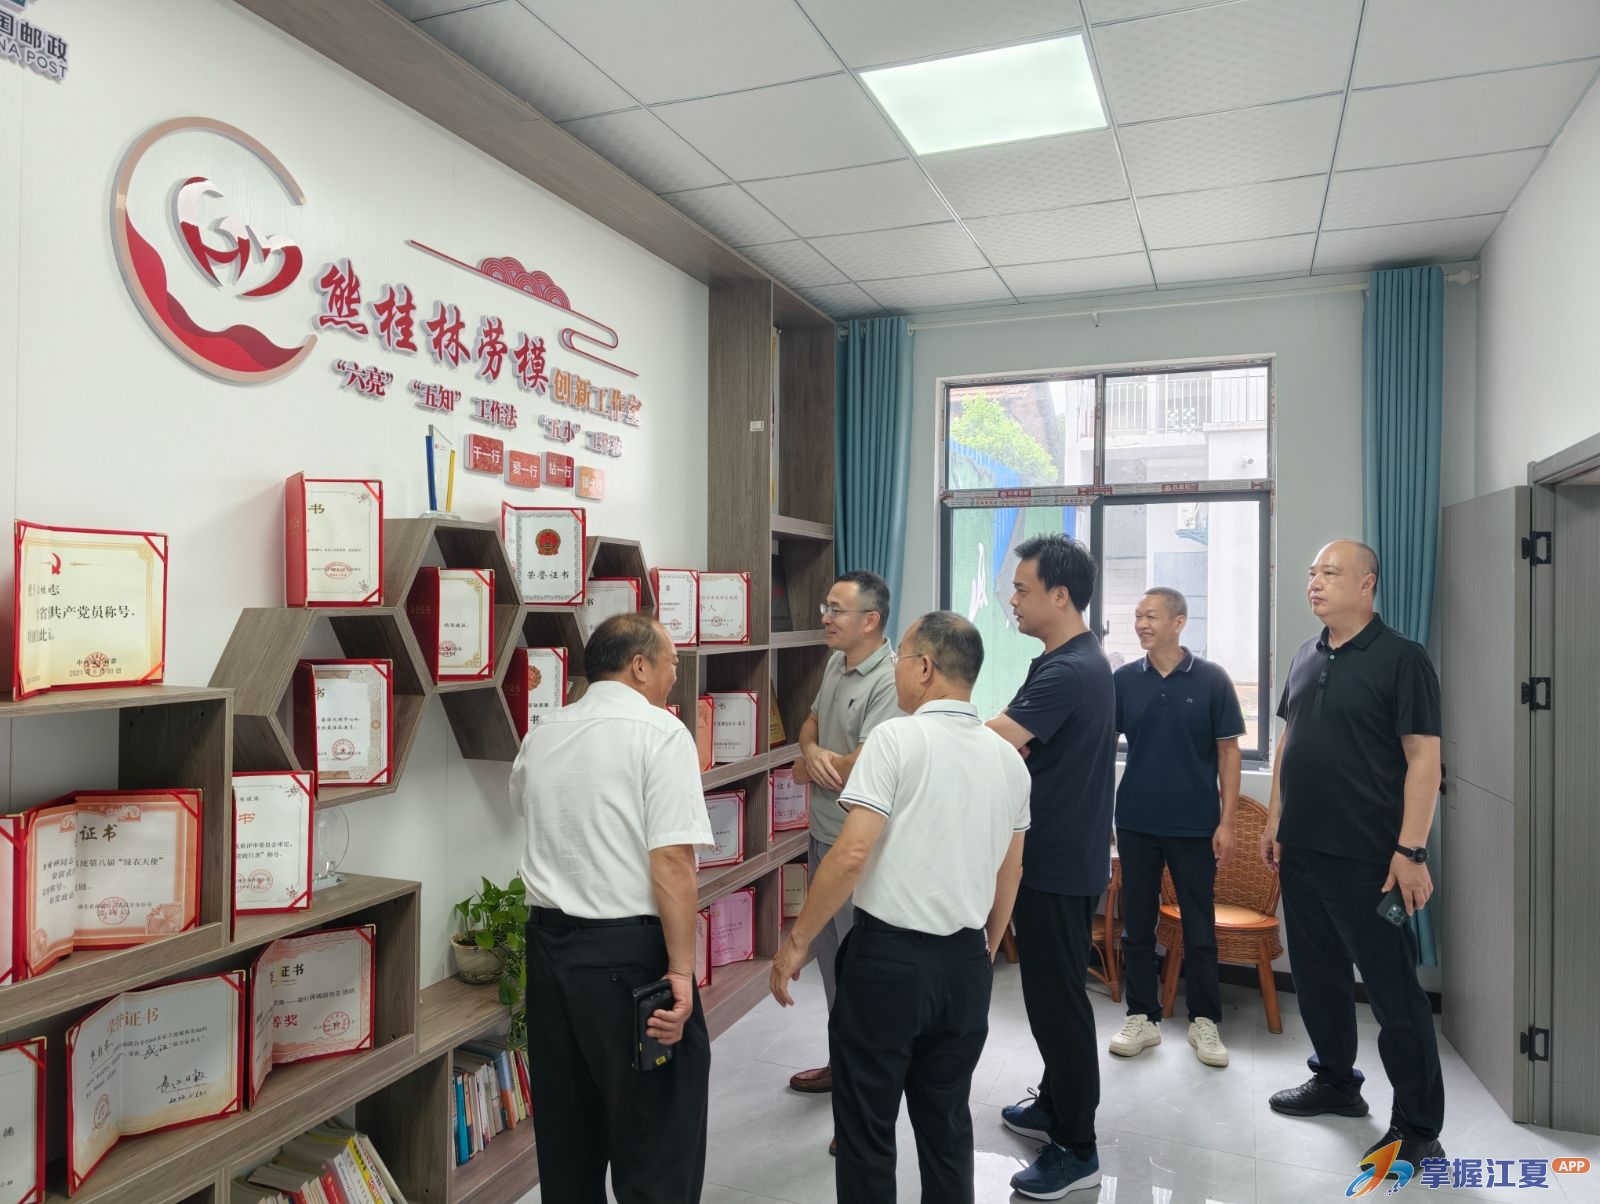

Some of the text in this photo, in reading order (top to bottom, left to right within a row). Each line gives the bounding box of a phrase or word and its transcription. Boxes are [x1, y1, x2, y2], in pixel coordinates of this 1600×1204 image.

[27, 50, 67, 78] POST
[318, 259, 643, 426] 熊桂林劳模 创新工作室
[336, 359, 394, 397] “六亮”
[412, 380, 462, 412] “五知”
[472, 398, 518, 429] 工作法
[473, 445, 500, 464] 干一行
[512, 461, 538, 478] 爱一行
[549, 463, 572, 478] 钻一行
[308, 503, 325, 515] 书
[526, 570, 570, 580] 荣誉证书
[238, 812, 256, 825] 书
[79, 824, 118, 842] 证书
